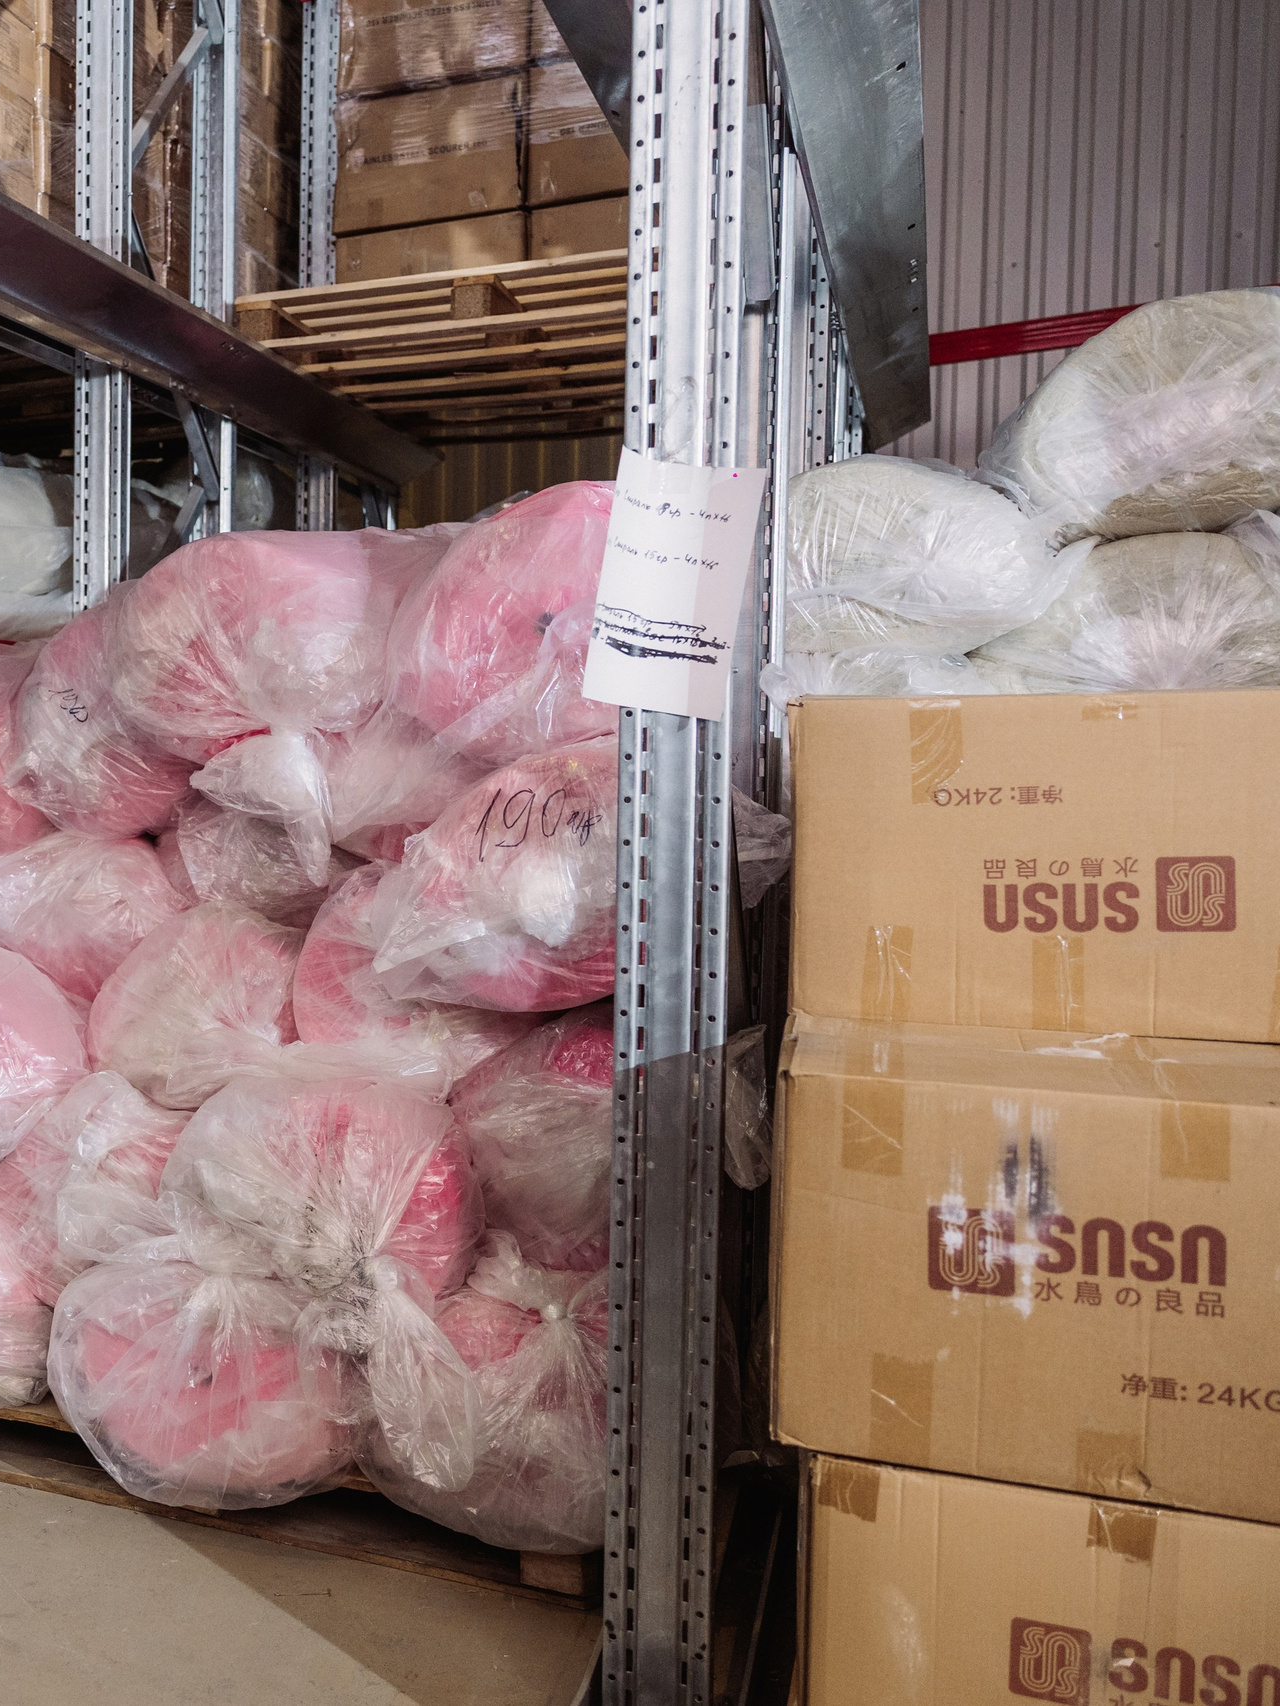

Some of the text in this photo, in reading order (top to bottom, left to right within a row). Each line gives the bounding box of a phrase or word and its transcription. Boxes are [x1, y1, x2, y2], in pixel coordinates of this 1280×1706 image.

[1035, 1277, 1226, 1319] 水鳥の良品
